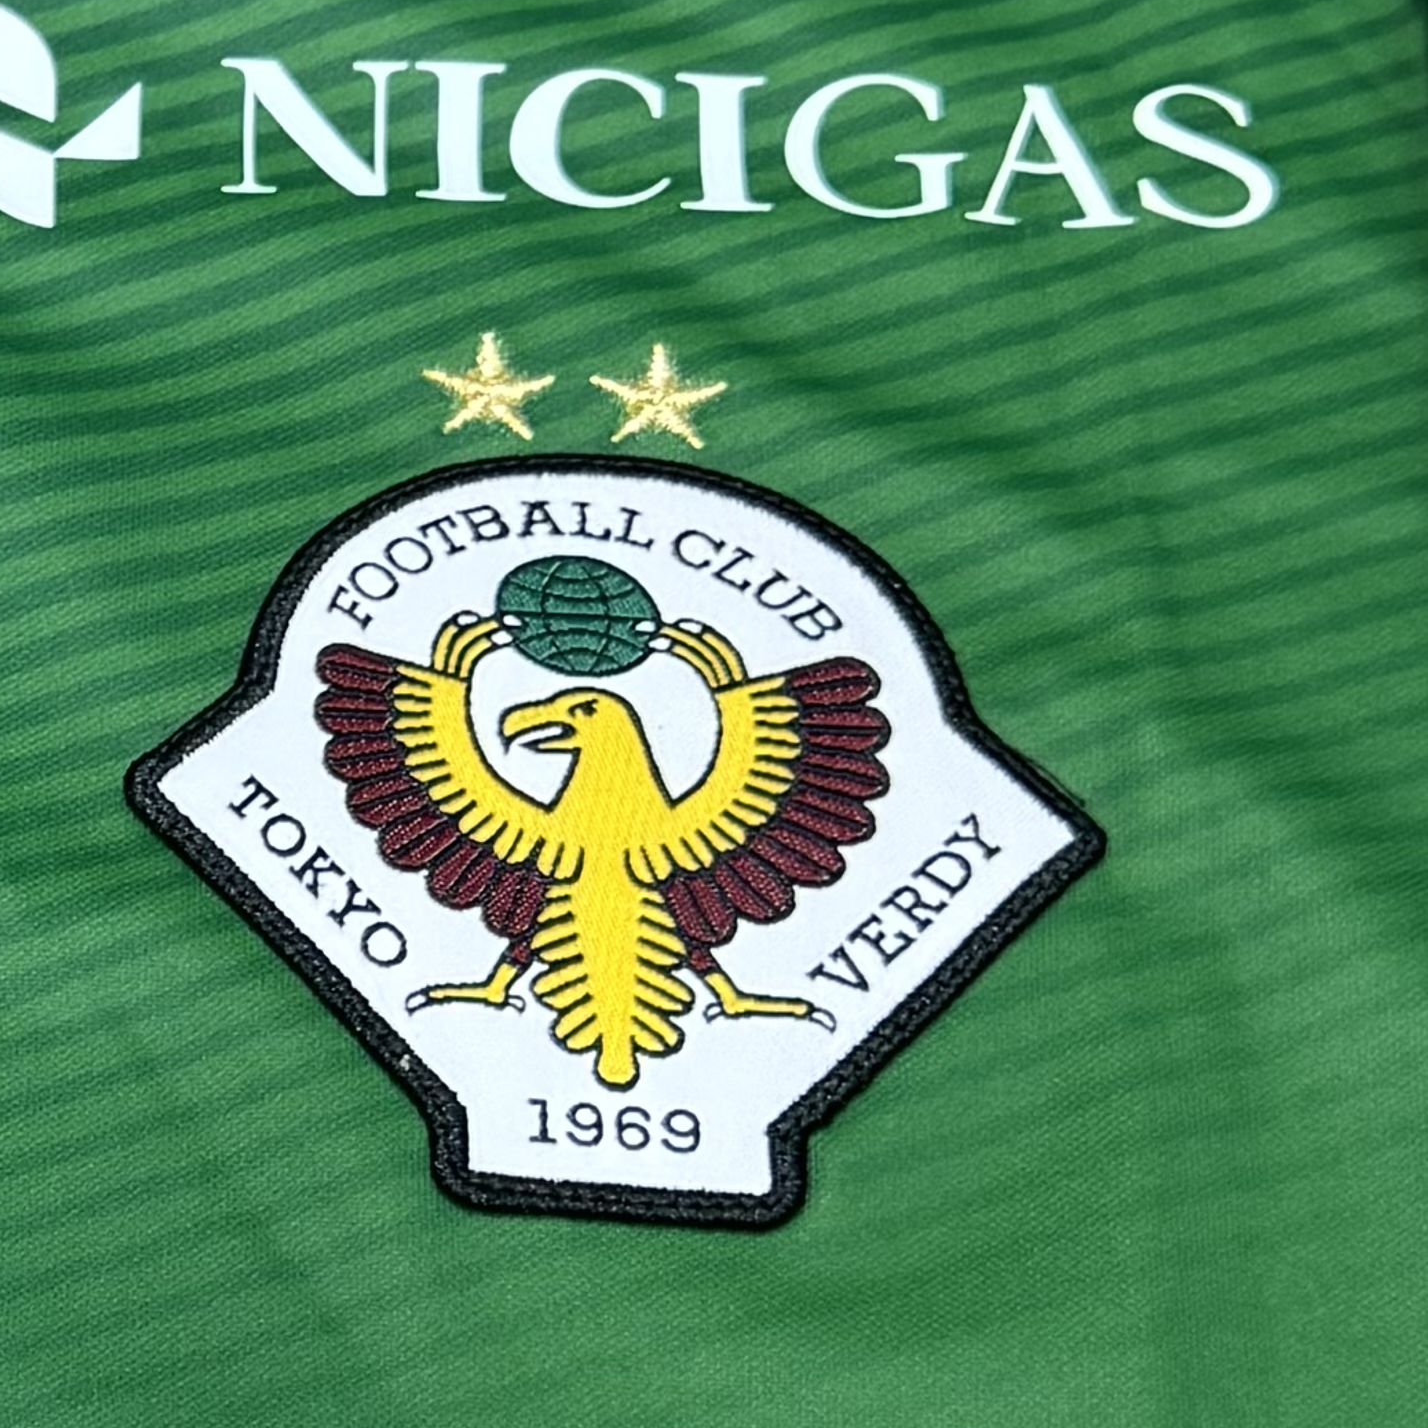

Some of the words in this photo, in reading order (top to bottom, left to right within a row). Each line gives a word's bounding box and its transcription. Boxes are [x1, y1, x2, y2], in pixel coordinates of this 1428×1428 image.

[219, 57, 1278, 230] NICIGAS
[327, 499, 655, 632] FOOTBALL
[670, 524, 844, 644] CLUB
[226, 776, 410, 971] TOKYO
[808, 812, 1005, 996] VERDY
[526, 1099, 703, 1153] 1969
